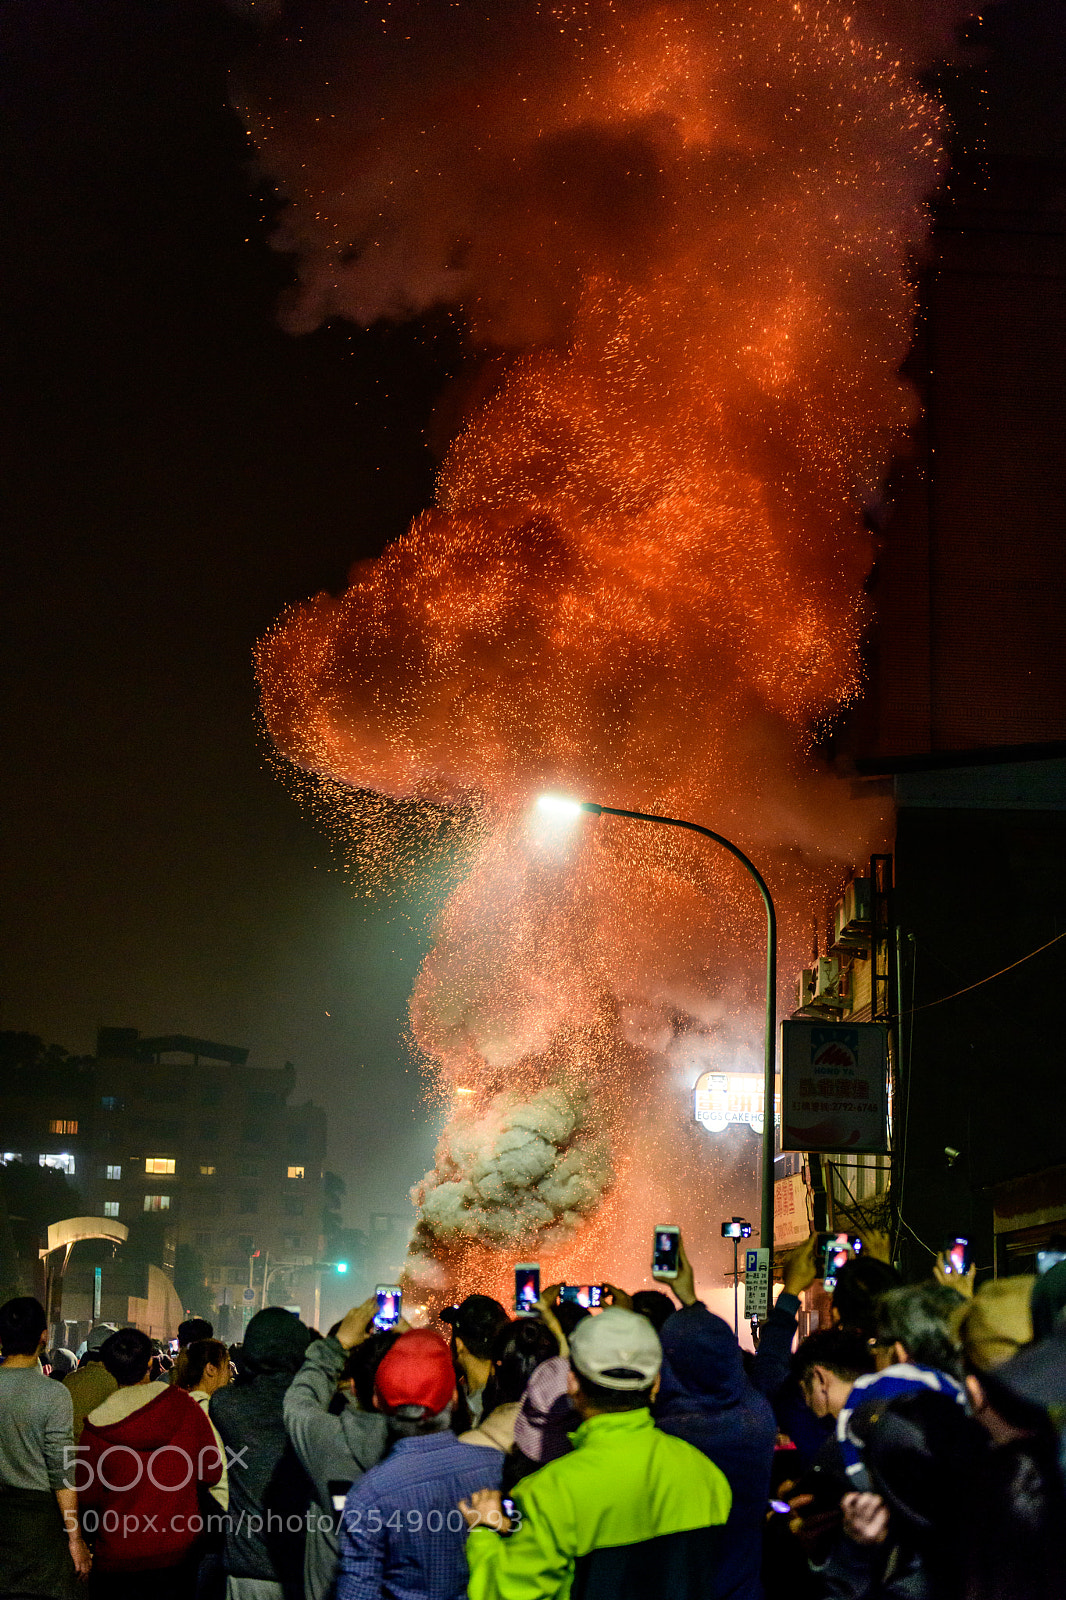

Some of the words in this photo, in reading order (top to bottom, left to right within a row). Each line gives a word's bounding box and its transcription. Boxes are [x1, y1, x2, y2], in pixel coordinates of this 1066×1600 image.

[697, 1111, 723, 1121] EGGS
[724, 1112, 750, 1122] CAKE
[751, 1113, 781, 1123] HOSE
[748, 1254, 756, 1269] P
